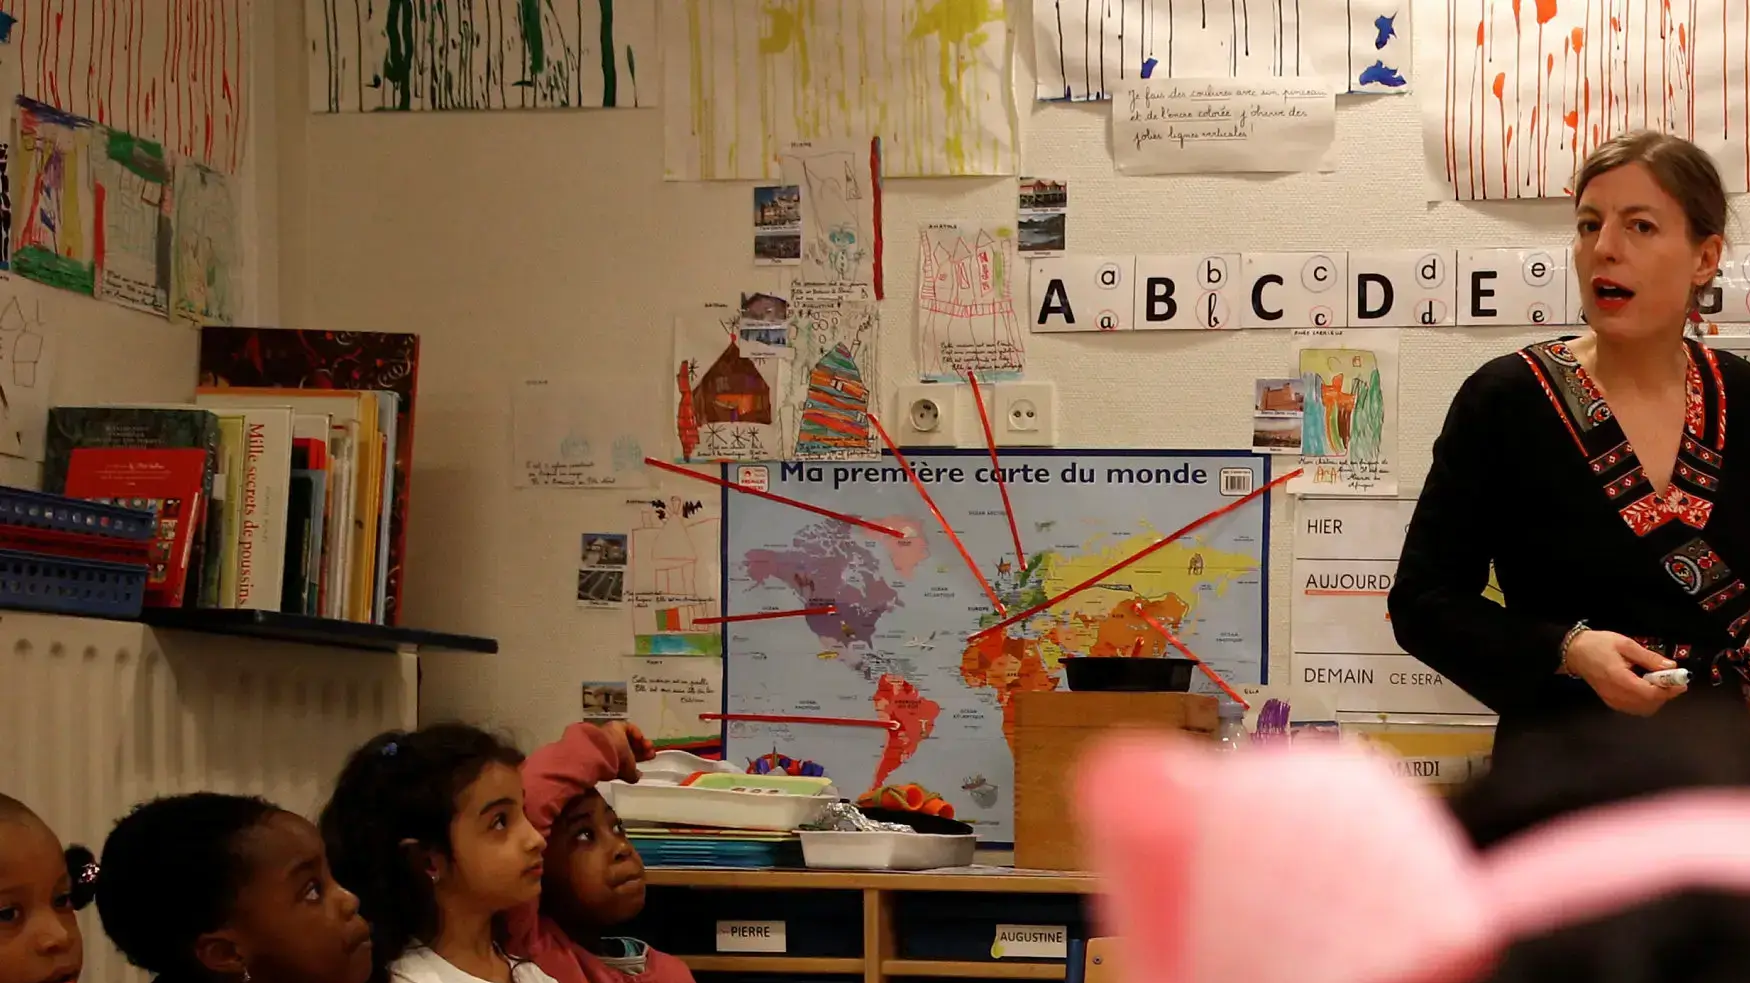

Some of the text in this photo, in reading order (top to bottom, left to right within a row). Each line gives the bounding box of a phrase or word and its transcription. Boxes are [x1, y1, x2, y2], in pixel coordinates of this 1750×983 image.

[1038, 279, 1075, 325] A
[1146, 278, 1178, 322] B
[1251, 275, 1284, 320] C
[1358, 274, 1394, 318] D
[1471, 271, 1498, 317] E
[781, 462, 822, 482] Ma
[833, 461, 963, 489] première
[975, 465, 1050, 483] carte
[1061, 462, 1095, 483] du
[1107, 463, 1208, 484] monde
[238, 423, 265, 605] Mille secrets de poussins
[1307, 519, 1343, 534] HIER
[1304, 668, 1443, 685] DEMAIN CE SERA
[731, 926, 771, 938] PIERRE
[1000, 932, 1062, 943] AUGUSTINE
